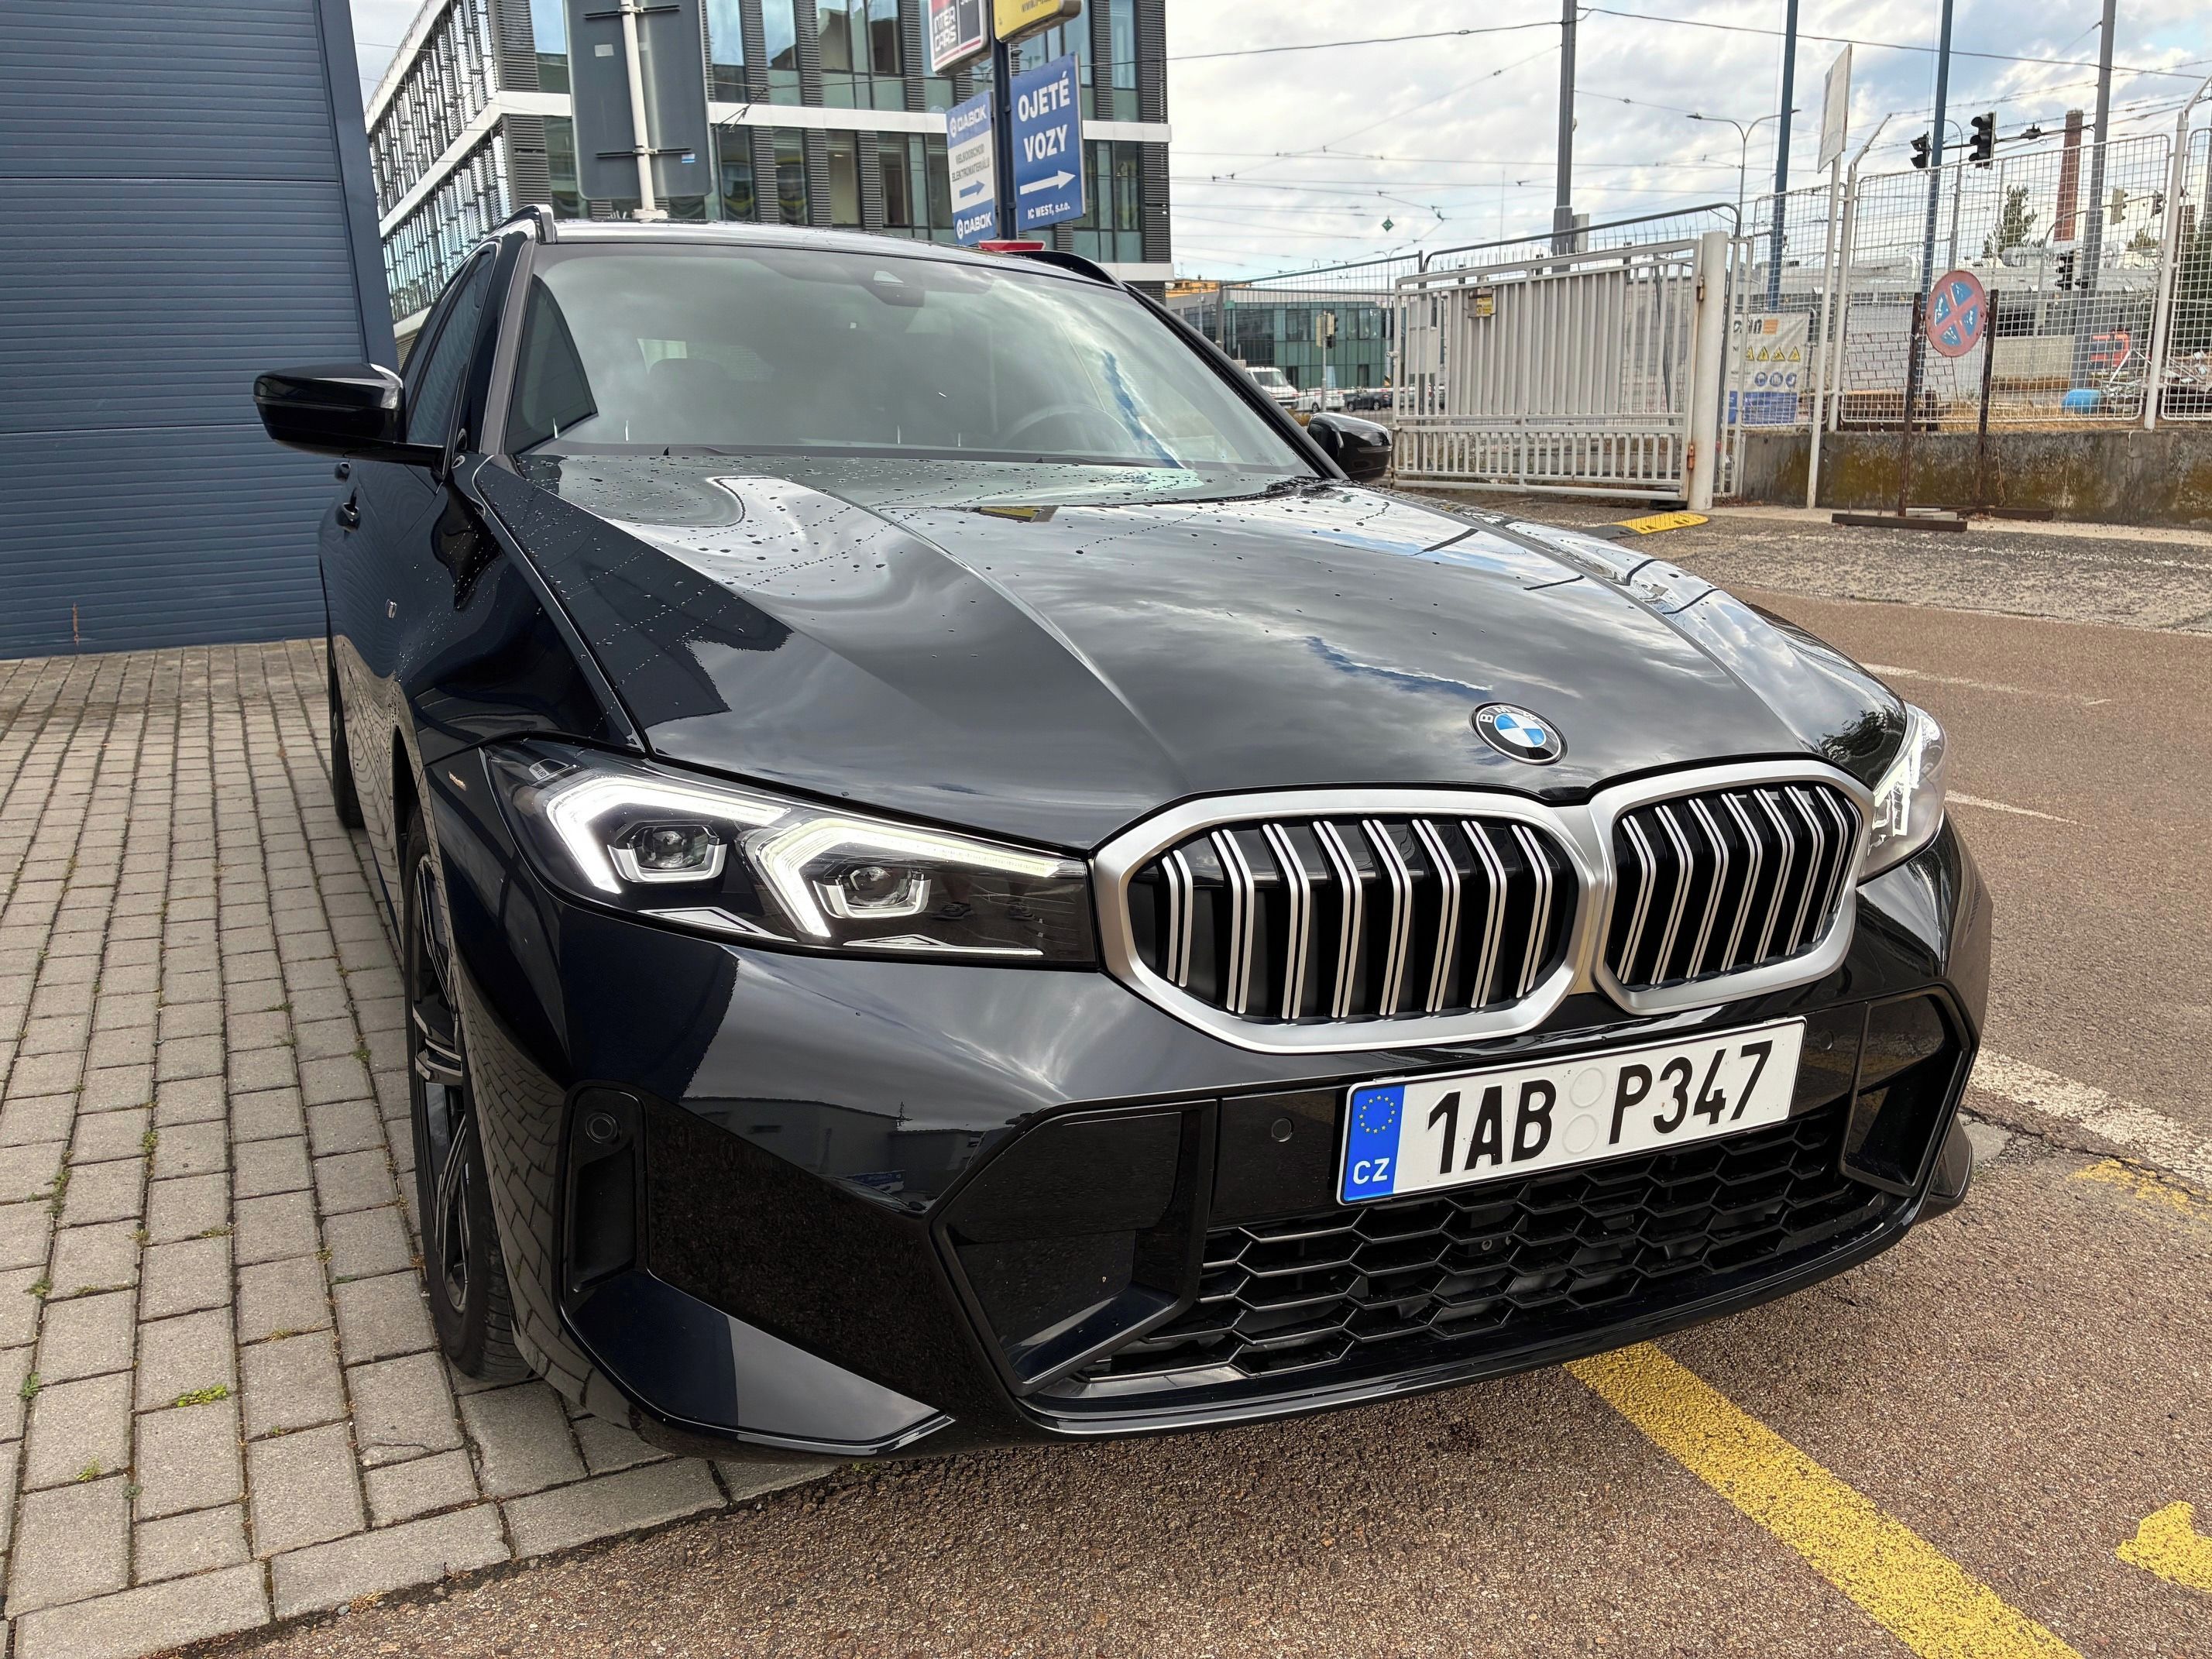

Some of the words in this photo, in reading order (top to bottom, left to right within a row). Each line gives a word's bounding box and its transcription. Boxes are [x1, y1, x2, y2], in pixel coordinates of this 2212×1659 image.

[1018, 70, 1070, 122] OJETÉ
[957, 105, 987, 132] DABOK
[1023, 124, 1068, 163] VOZY
[963, 211, 993, 234] DABOK
[1027, 208, 1035, 220] IC
[1036, 204, 1054, 218] WEST,
[1055, 201, 1070, 213] s.r.o.
[1427, 1078, 1557, 1175] 1AB
[1608, 1040, 1774, 1146] P347
[1352, 1156, 1390, 1185] CZ
